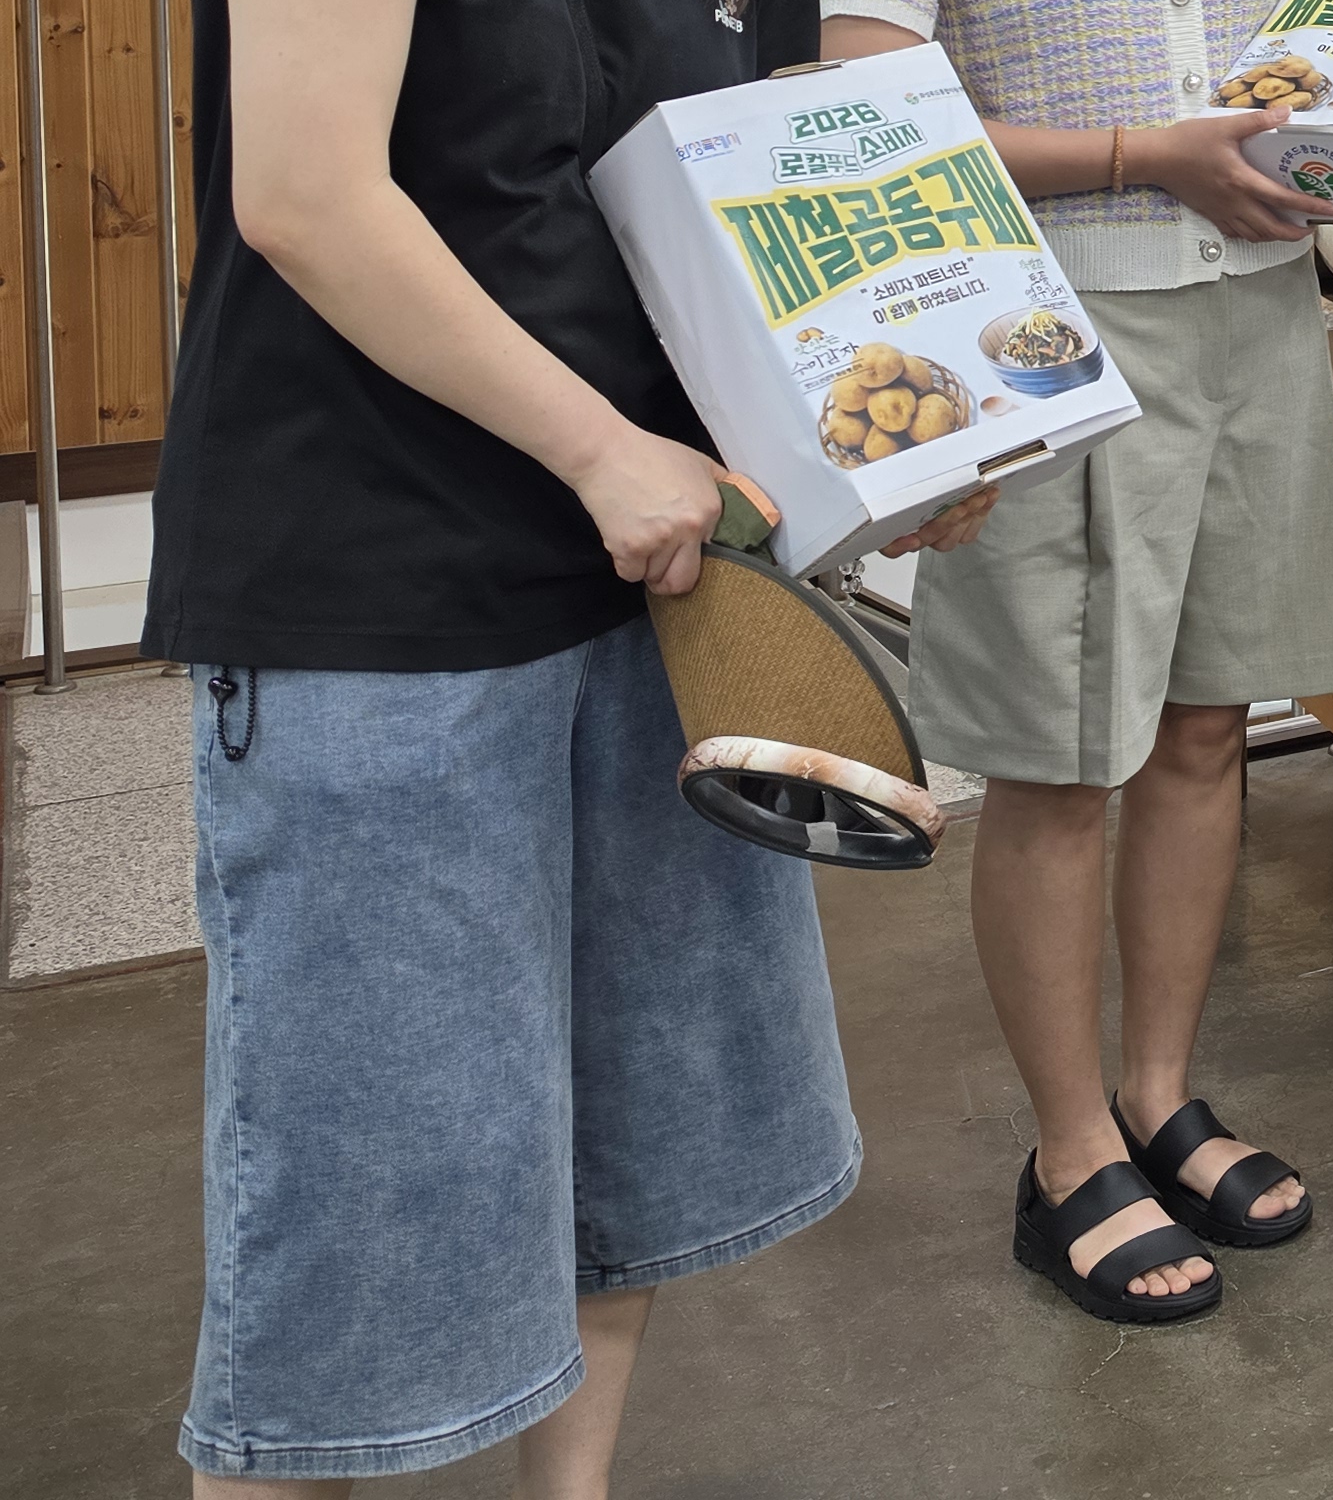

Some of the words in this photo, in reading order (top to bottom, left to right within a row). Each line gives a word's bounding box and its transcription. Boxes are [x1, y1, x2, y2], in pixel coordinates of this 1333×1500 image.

[790, 103, 882, 140] 2026
[859, 124, 922, 164] 소비자
[779, 153, 862, 176] 로컬푸드
[721, 144, 1037, 320] 제철공동구매
[872, 308, 889, 324] 이
[889, 300, 919, 320] 함께
